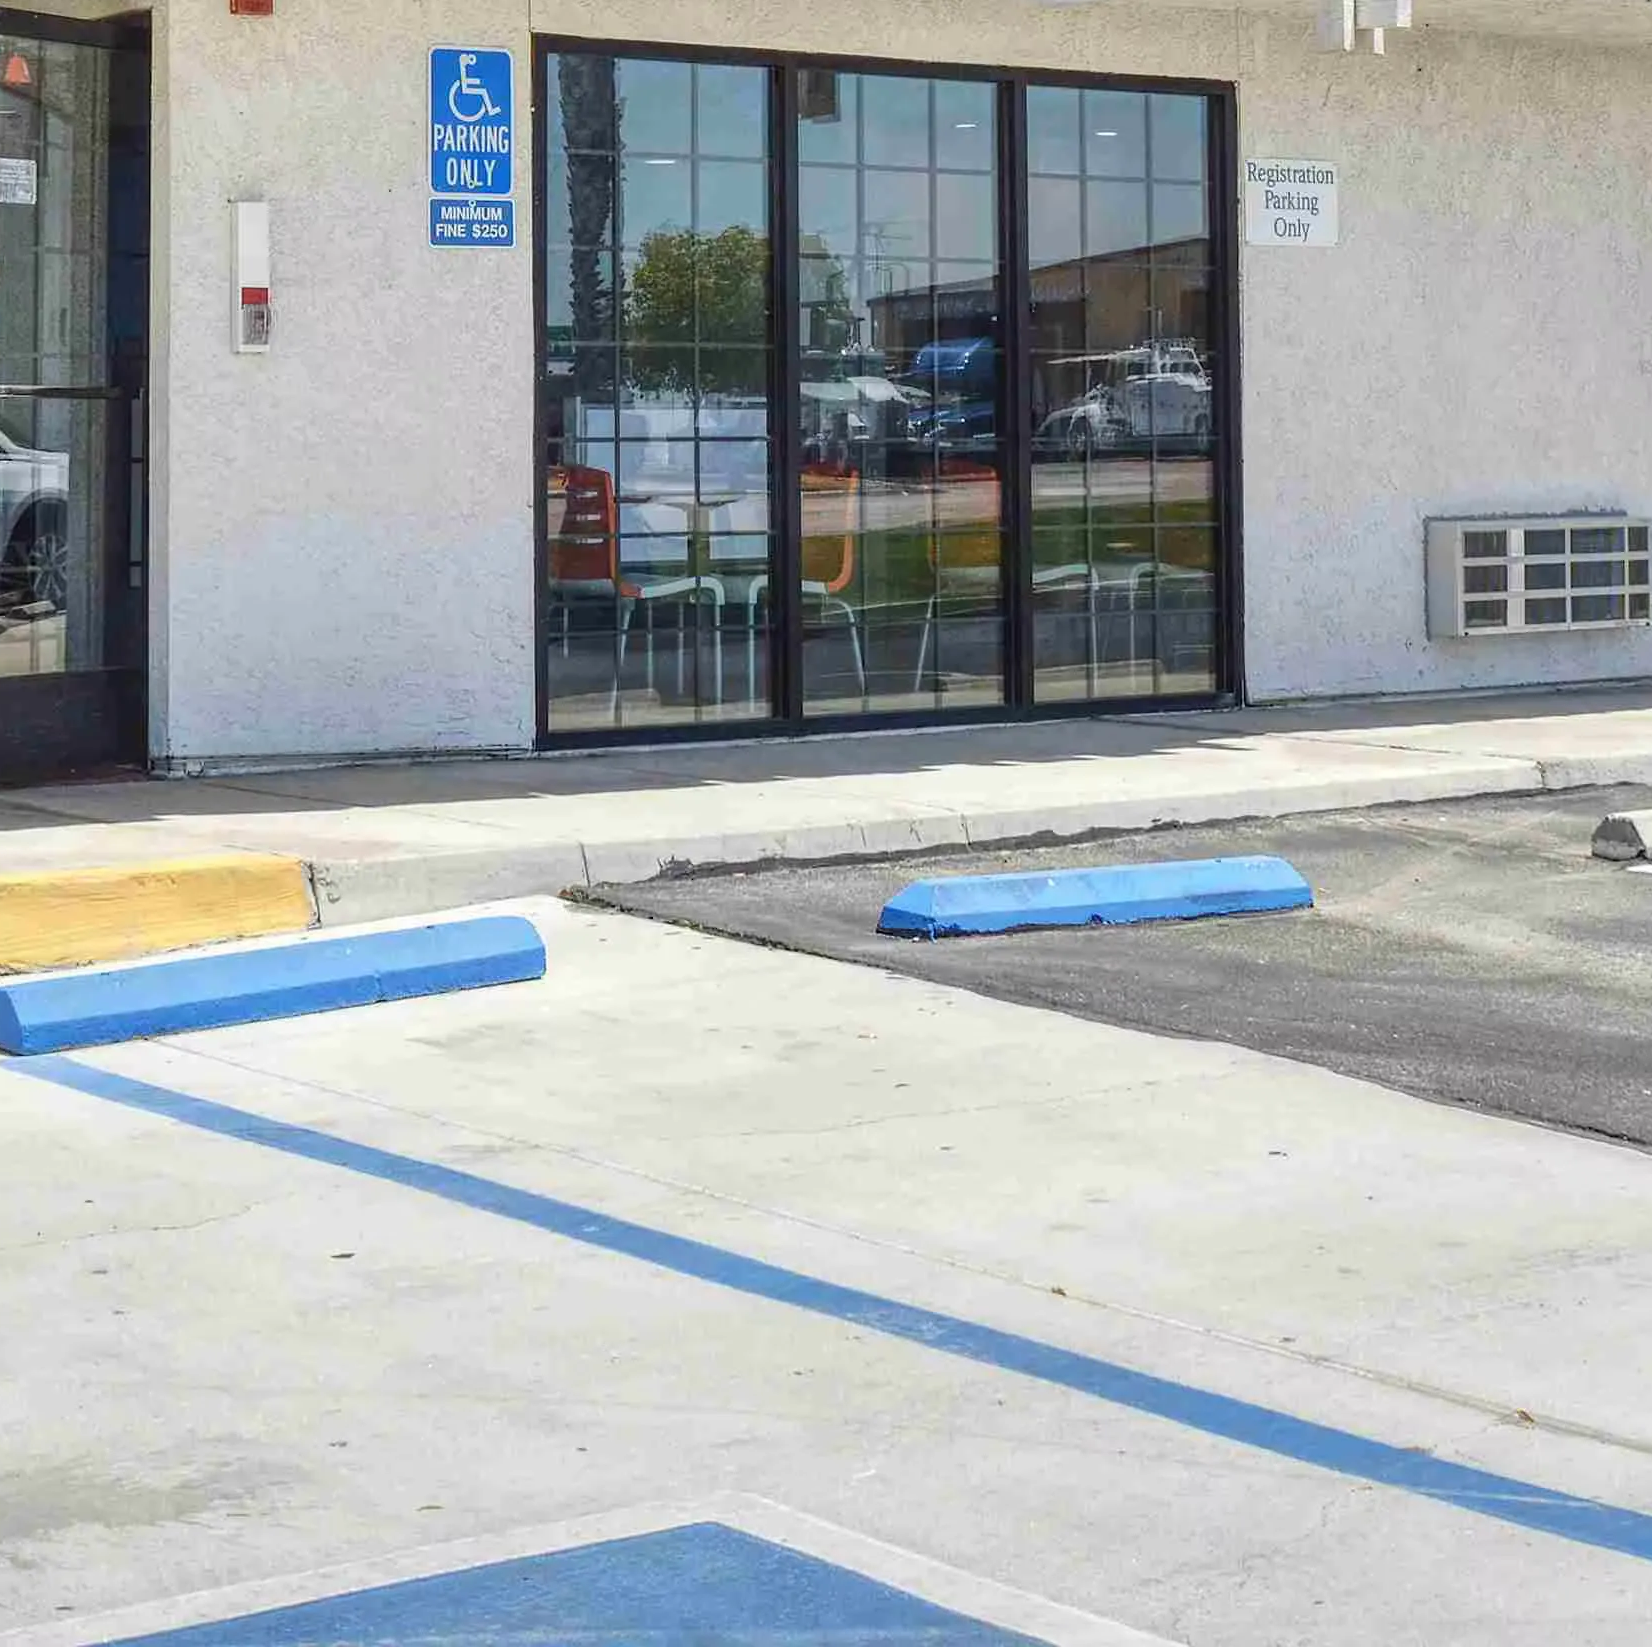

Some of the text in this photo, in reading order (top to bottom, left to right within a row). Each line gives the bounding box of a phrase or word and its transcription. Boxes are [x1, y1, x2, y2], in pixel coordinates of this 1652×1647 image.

[434, 124, 509, 153] PARKING
[446, 157, 498, 187] ONLY
[1247, 162, 1334, 187] Registration
[441, 206, 502, 221] MINIMUM
[1264, 190, 1319, 216] Parking
[435, 223, 508, 240] FINE $250
[1274, 217, 1310, 242] Only
